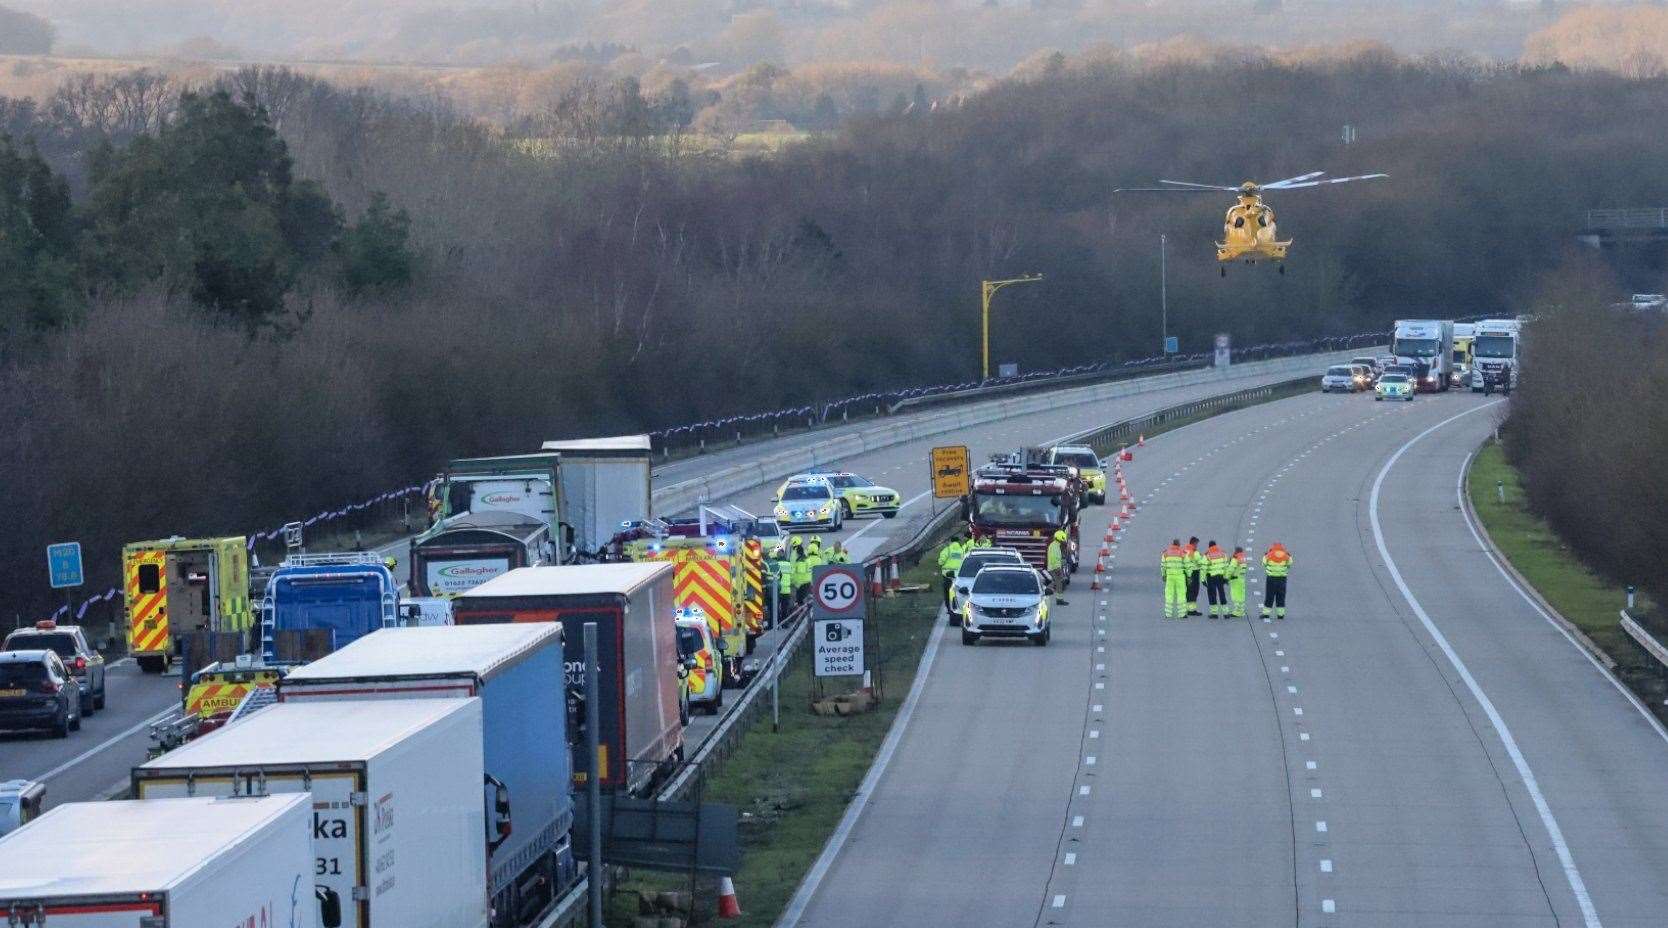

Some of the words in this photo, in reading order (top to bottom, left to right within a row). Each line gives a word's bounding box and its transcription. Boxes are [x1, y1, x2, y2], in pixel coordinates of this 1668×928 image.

[488, 495, 520, 504] Gallagher
[451, 566, 498, 576] Gallagher
[824, 582, 856, 601] 50
[819, 645, 861, 655] Average
[825, 654, 855, 664] speed
[825, 664, 855, 673] check
[313, 811, 347, 839] ka
[316, 857, 342, 875] 31
